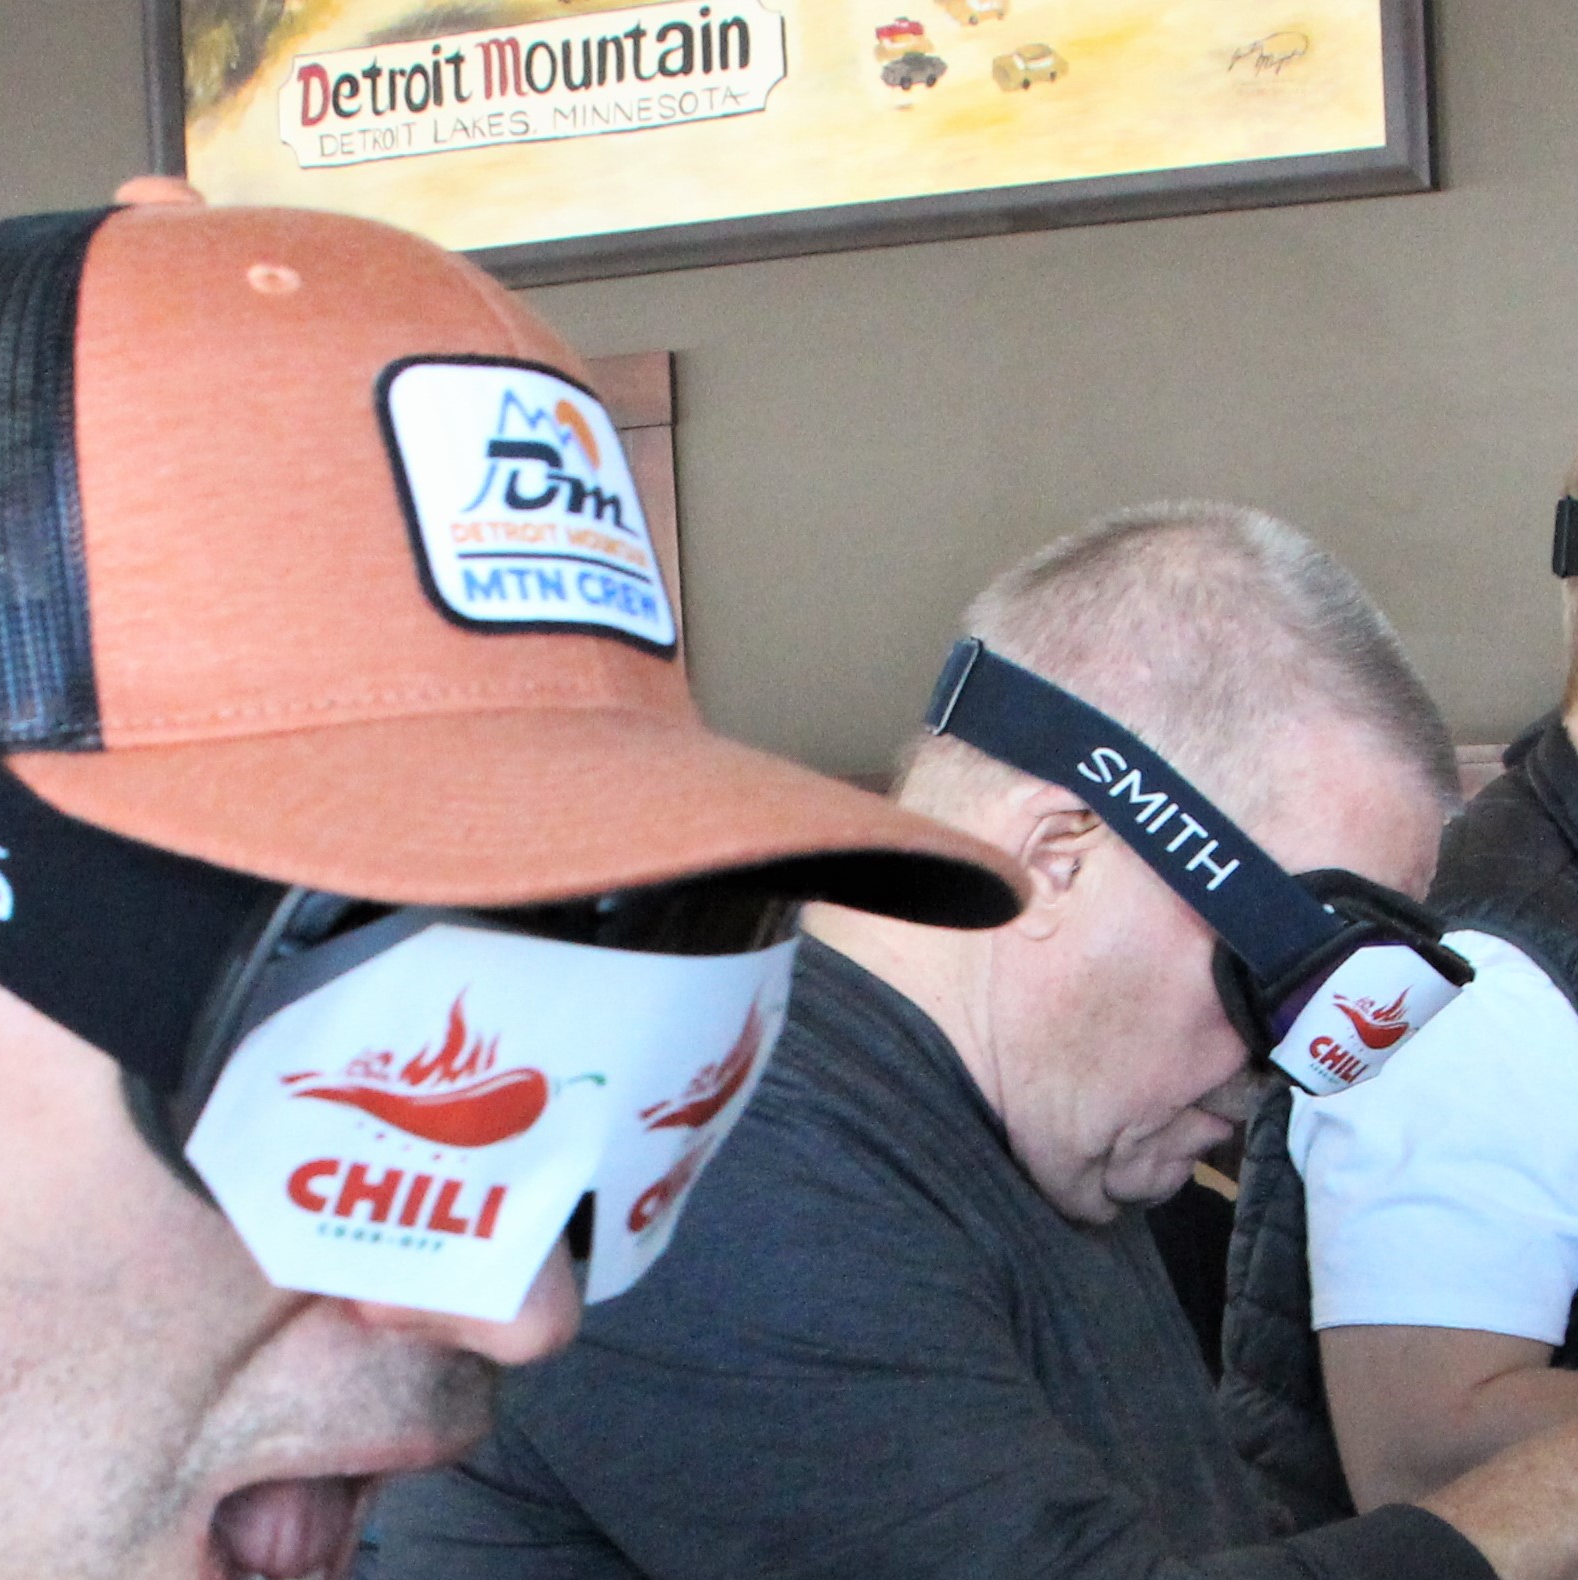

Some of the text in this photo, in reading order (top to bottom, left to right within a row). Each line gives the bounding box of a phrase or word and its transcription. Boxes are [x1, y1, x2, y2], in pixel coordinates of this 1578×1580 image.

[297, 5, 751, 127] Detroit Mountain
[319, 122, 417, 158] DETROIT
[553, 85, 750, 130] MINNESOTA
[450, 522, 556, 543] DETROIT
[462, 567, 568, 601] MTN
[1076, 746, 1241, 892] SMITH
[1309, 1035, 1370, 1084] CHILI
[287, 1158, 508, 1241] CHILI
